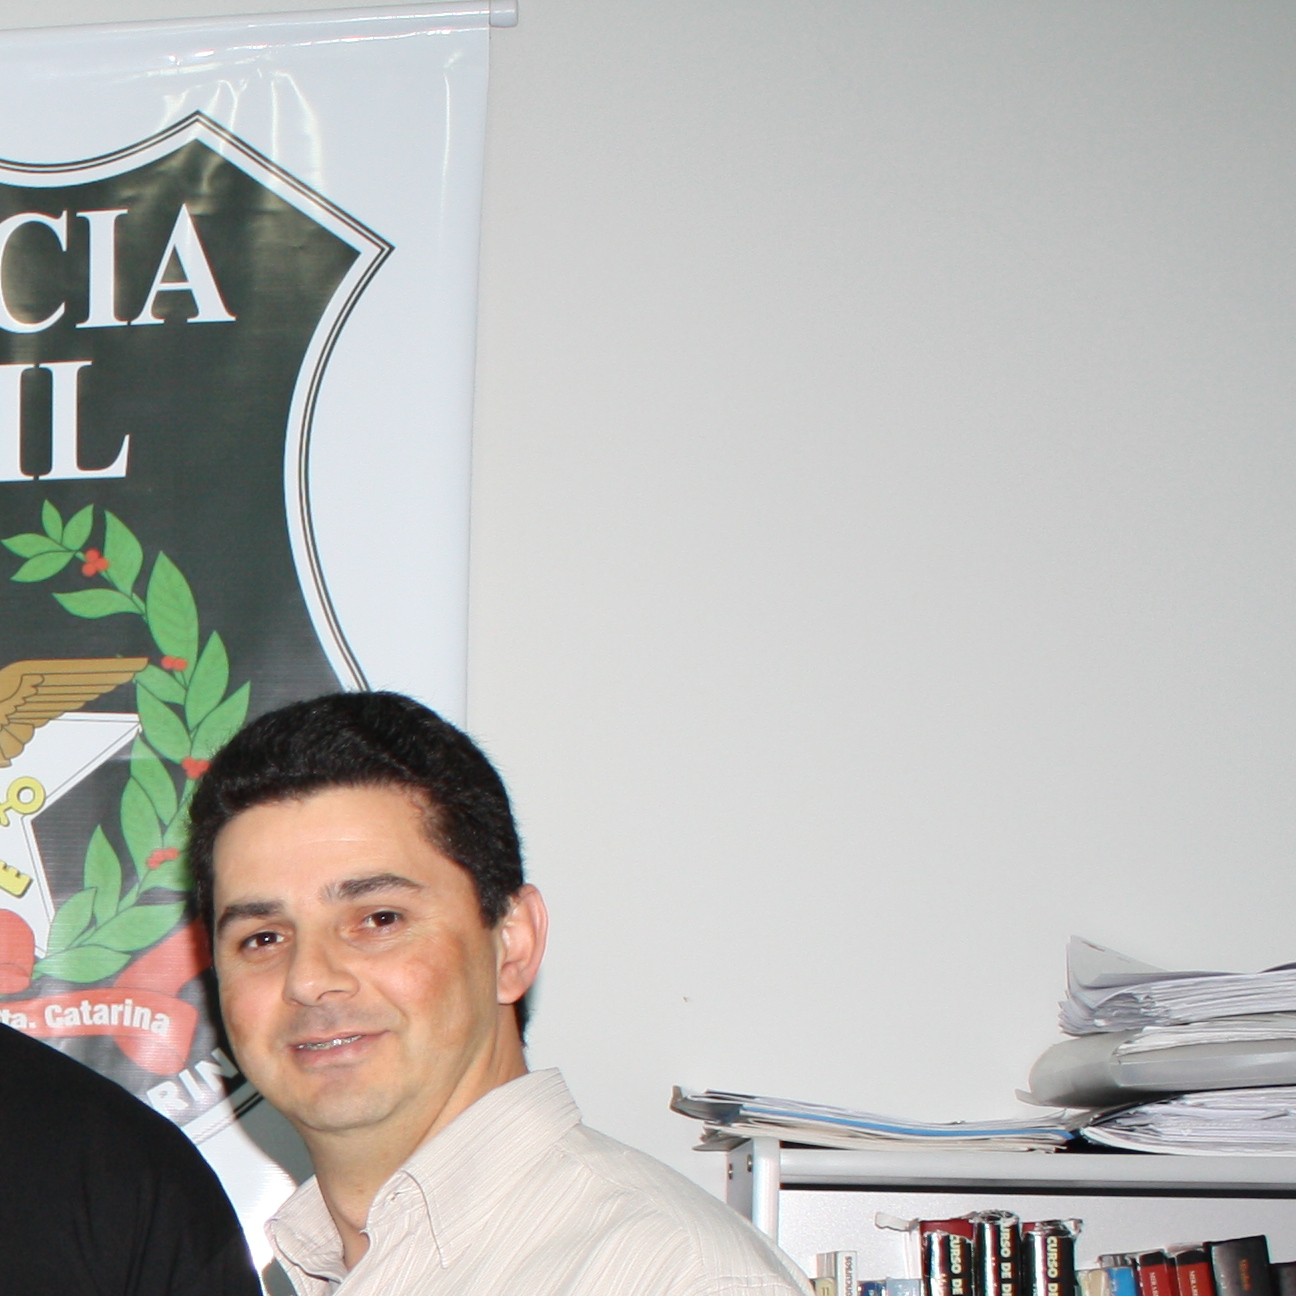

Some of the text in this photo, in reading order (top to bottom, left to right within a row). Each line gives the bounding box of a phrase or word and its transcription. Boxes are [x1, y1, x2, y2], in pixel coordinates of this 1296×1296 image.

[45, 999, 171, 1036] Catarina
[999, 1222, 1012, 1258] URSO
[1047, 1236, 1058, 1279] CURSO
[951, 1278, 963, 1295] DE
[1000, 1262, 1012, 1279] DE
